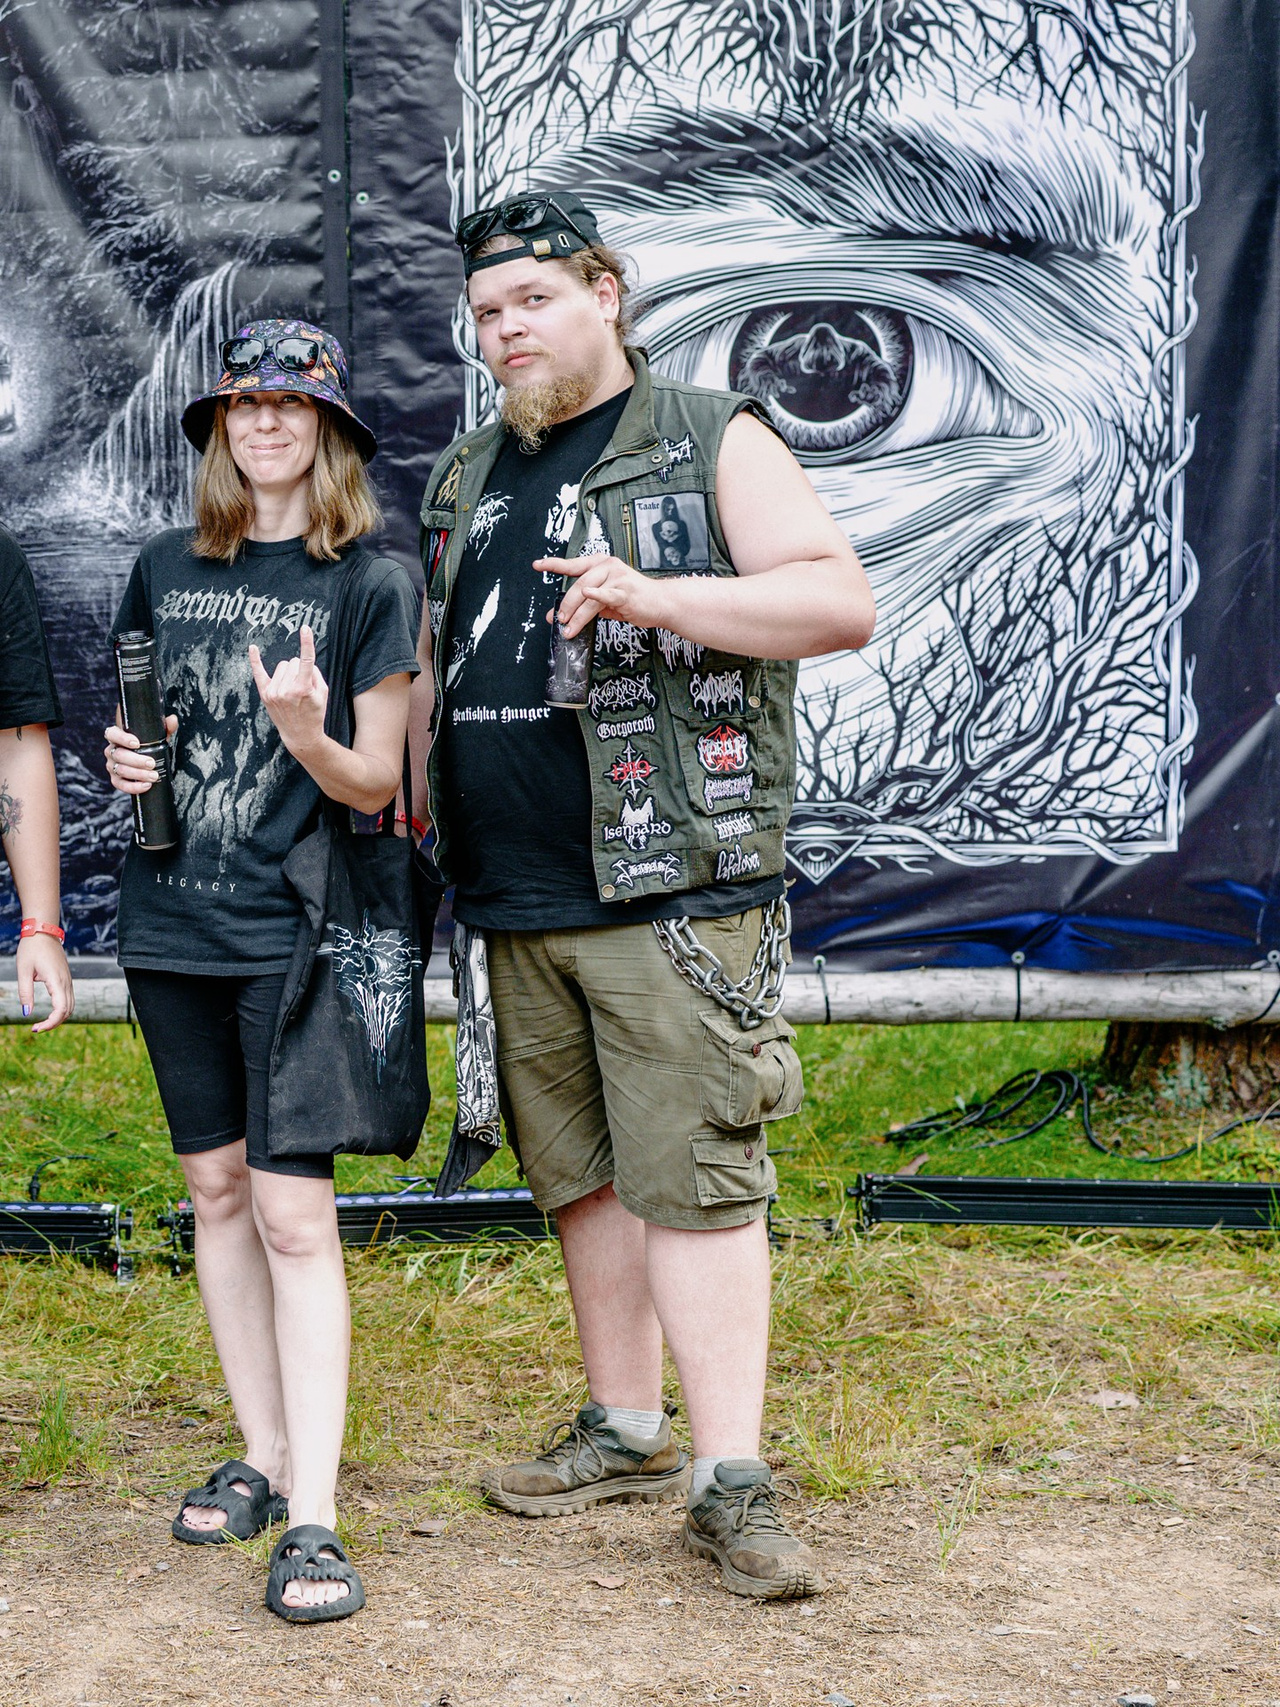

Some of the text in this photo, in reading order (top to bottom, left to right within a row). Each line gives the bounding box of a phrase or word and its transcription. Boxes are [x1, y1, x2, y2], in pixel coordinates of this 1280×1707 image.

[500, 706, 551, 723] Hunger
[597, 713, 655, 740] Gorgoroth
[156, 873, 236, 893] LEGACY
